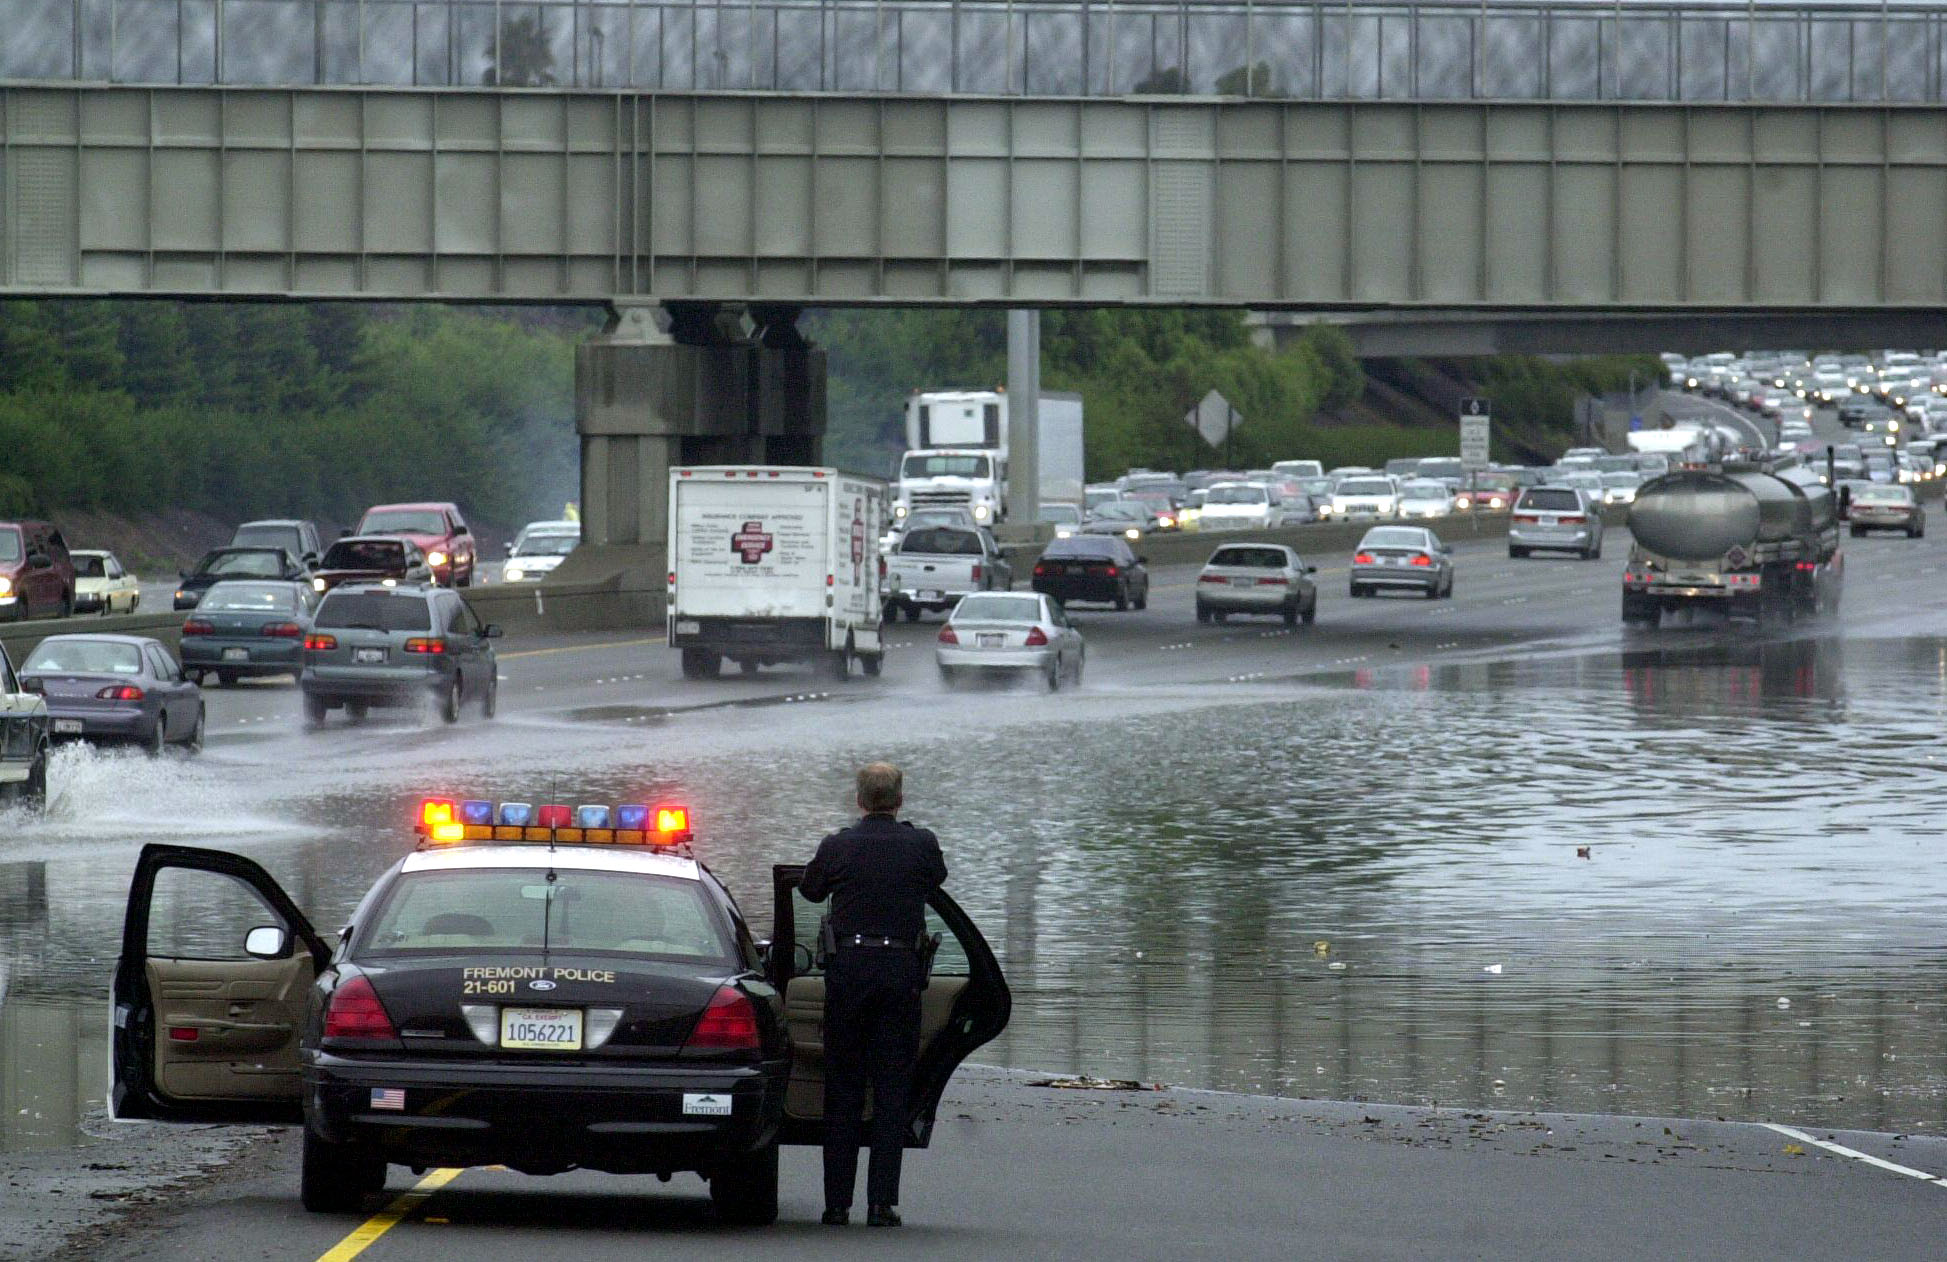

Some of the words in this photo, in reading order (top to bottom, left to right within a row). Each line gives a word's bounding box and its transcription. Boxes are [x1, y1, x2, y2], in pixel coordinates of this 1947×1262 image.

[463, 967, 547, 979] FREMONT
[554, 968, 616, 983] POLICE
[463, 980, 515, 994] 21-601
[508, 1023, 575, 1043] 1056221
[685, 1103, 730, 1114] Fremont
